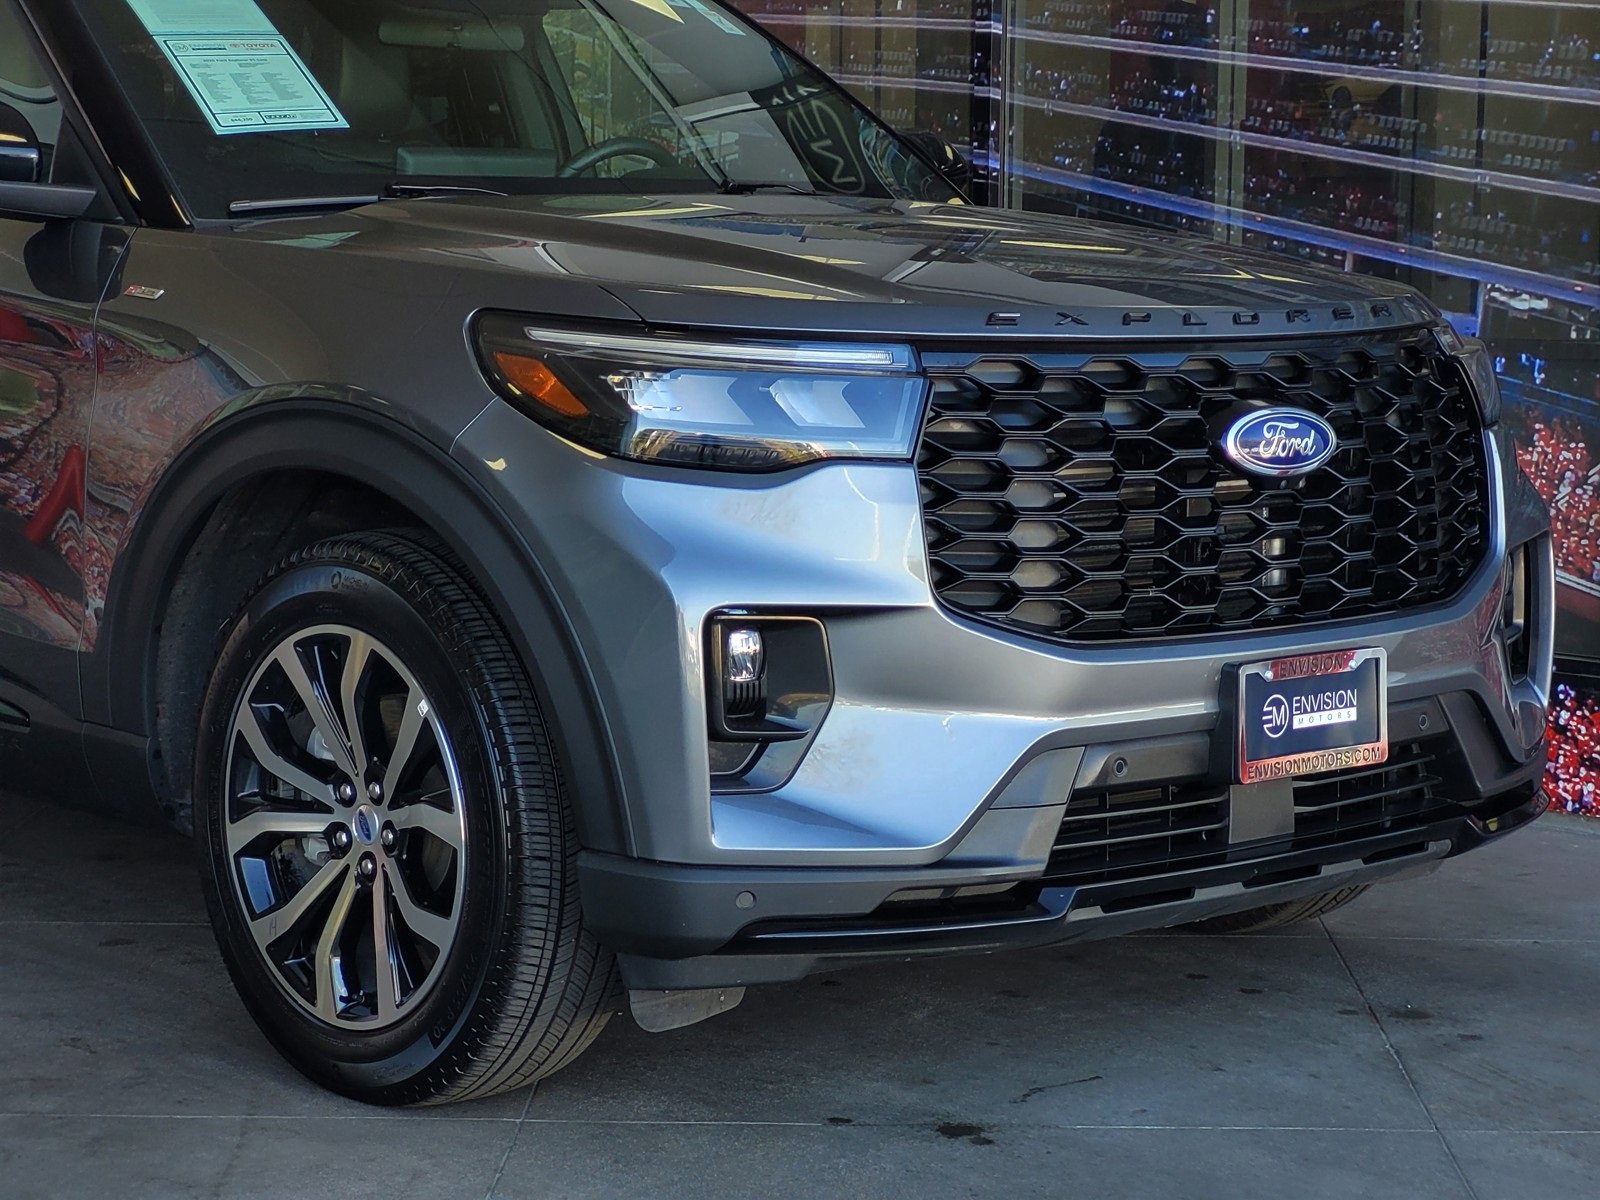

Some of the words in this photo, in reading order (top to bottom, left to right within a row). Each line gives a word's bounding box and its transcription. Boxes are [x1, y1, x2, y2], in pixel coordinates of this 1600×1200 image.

[985, 303, 1392, 326] EXPLORER
[1260, 421, 1317, 459] Ford
[1279, 654, 1344, 677] ENVISION
[1292, 688, 1357, 715] ENVISION
[1298, 711, 1351, 725] MOTORS
[1248, 747, 1381, 779] ENVISIONMOTORS.COM
